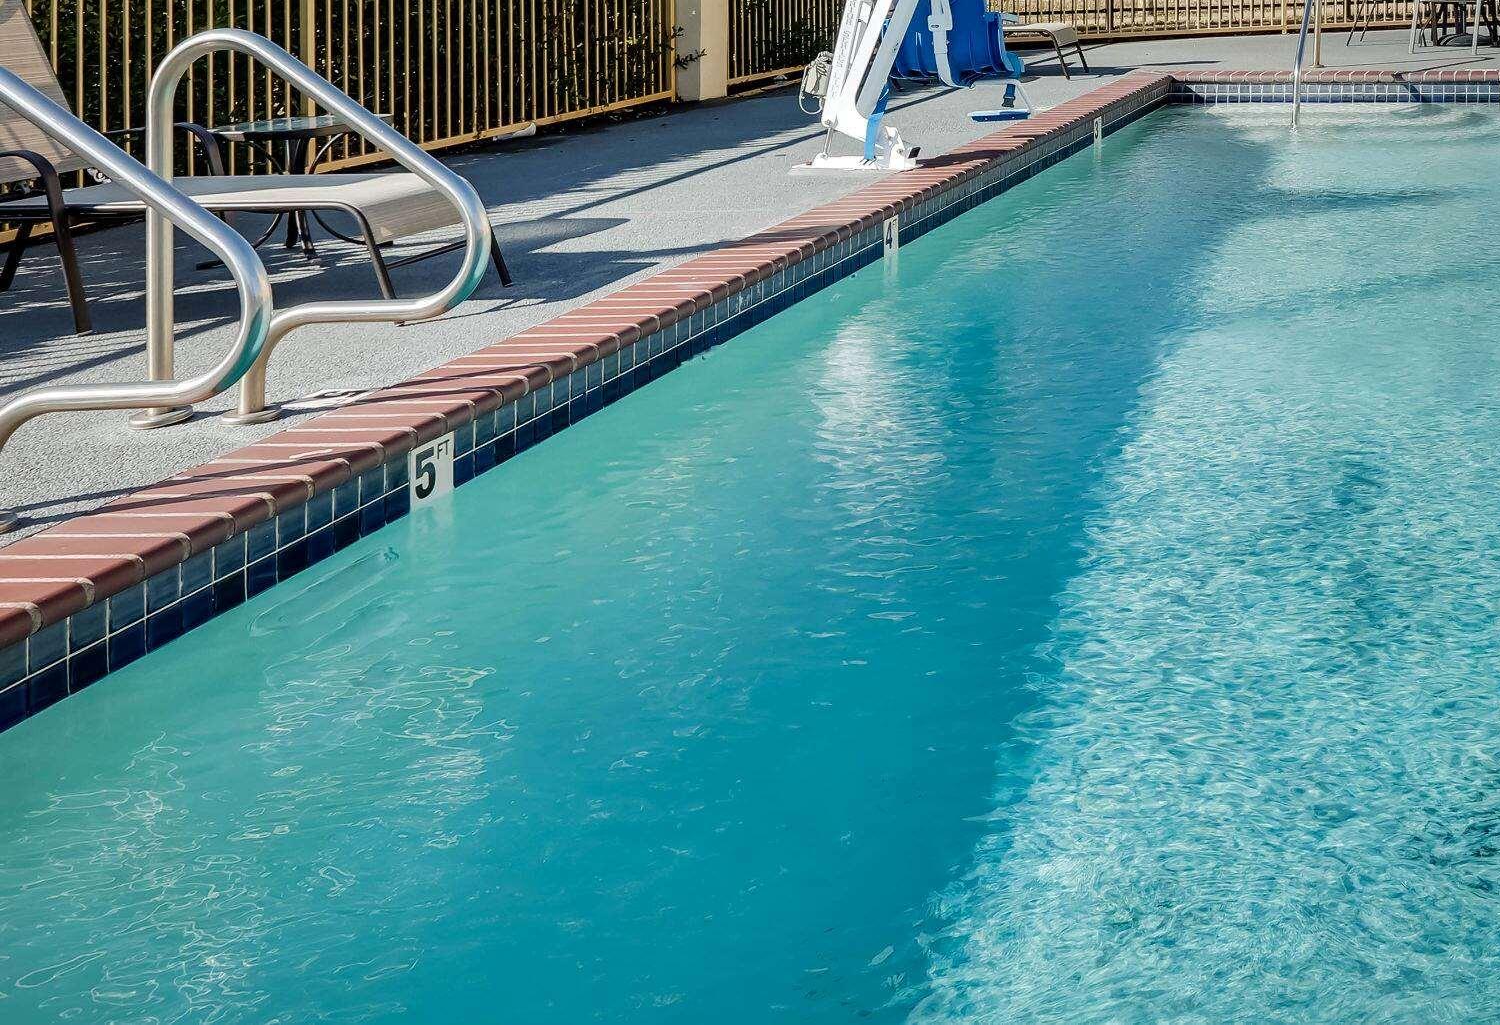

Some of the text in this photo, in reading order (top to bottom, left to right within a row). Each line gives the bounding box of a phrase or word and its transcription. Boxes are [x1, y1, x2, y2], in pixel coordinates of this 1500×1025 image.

[1094, 120, 1099, 140] 3
[885, 220, 893, 250] 4
[415, 439, 450, 500] 5 FT
